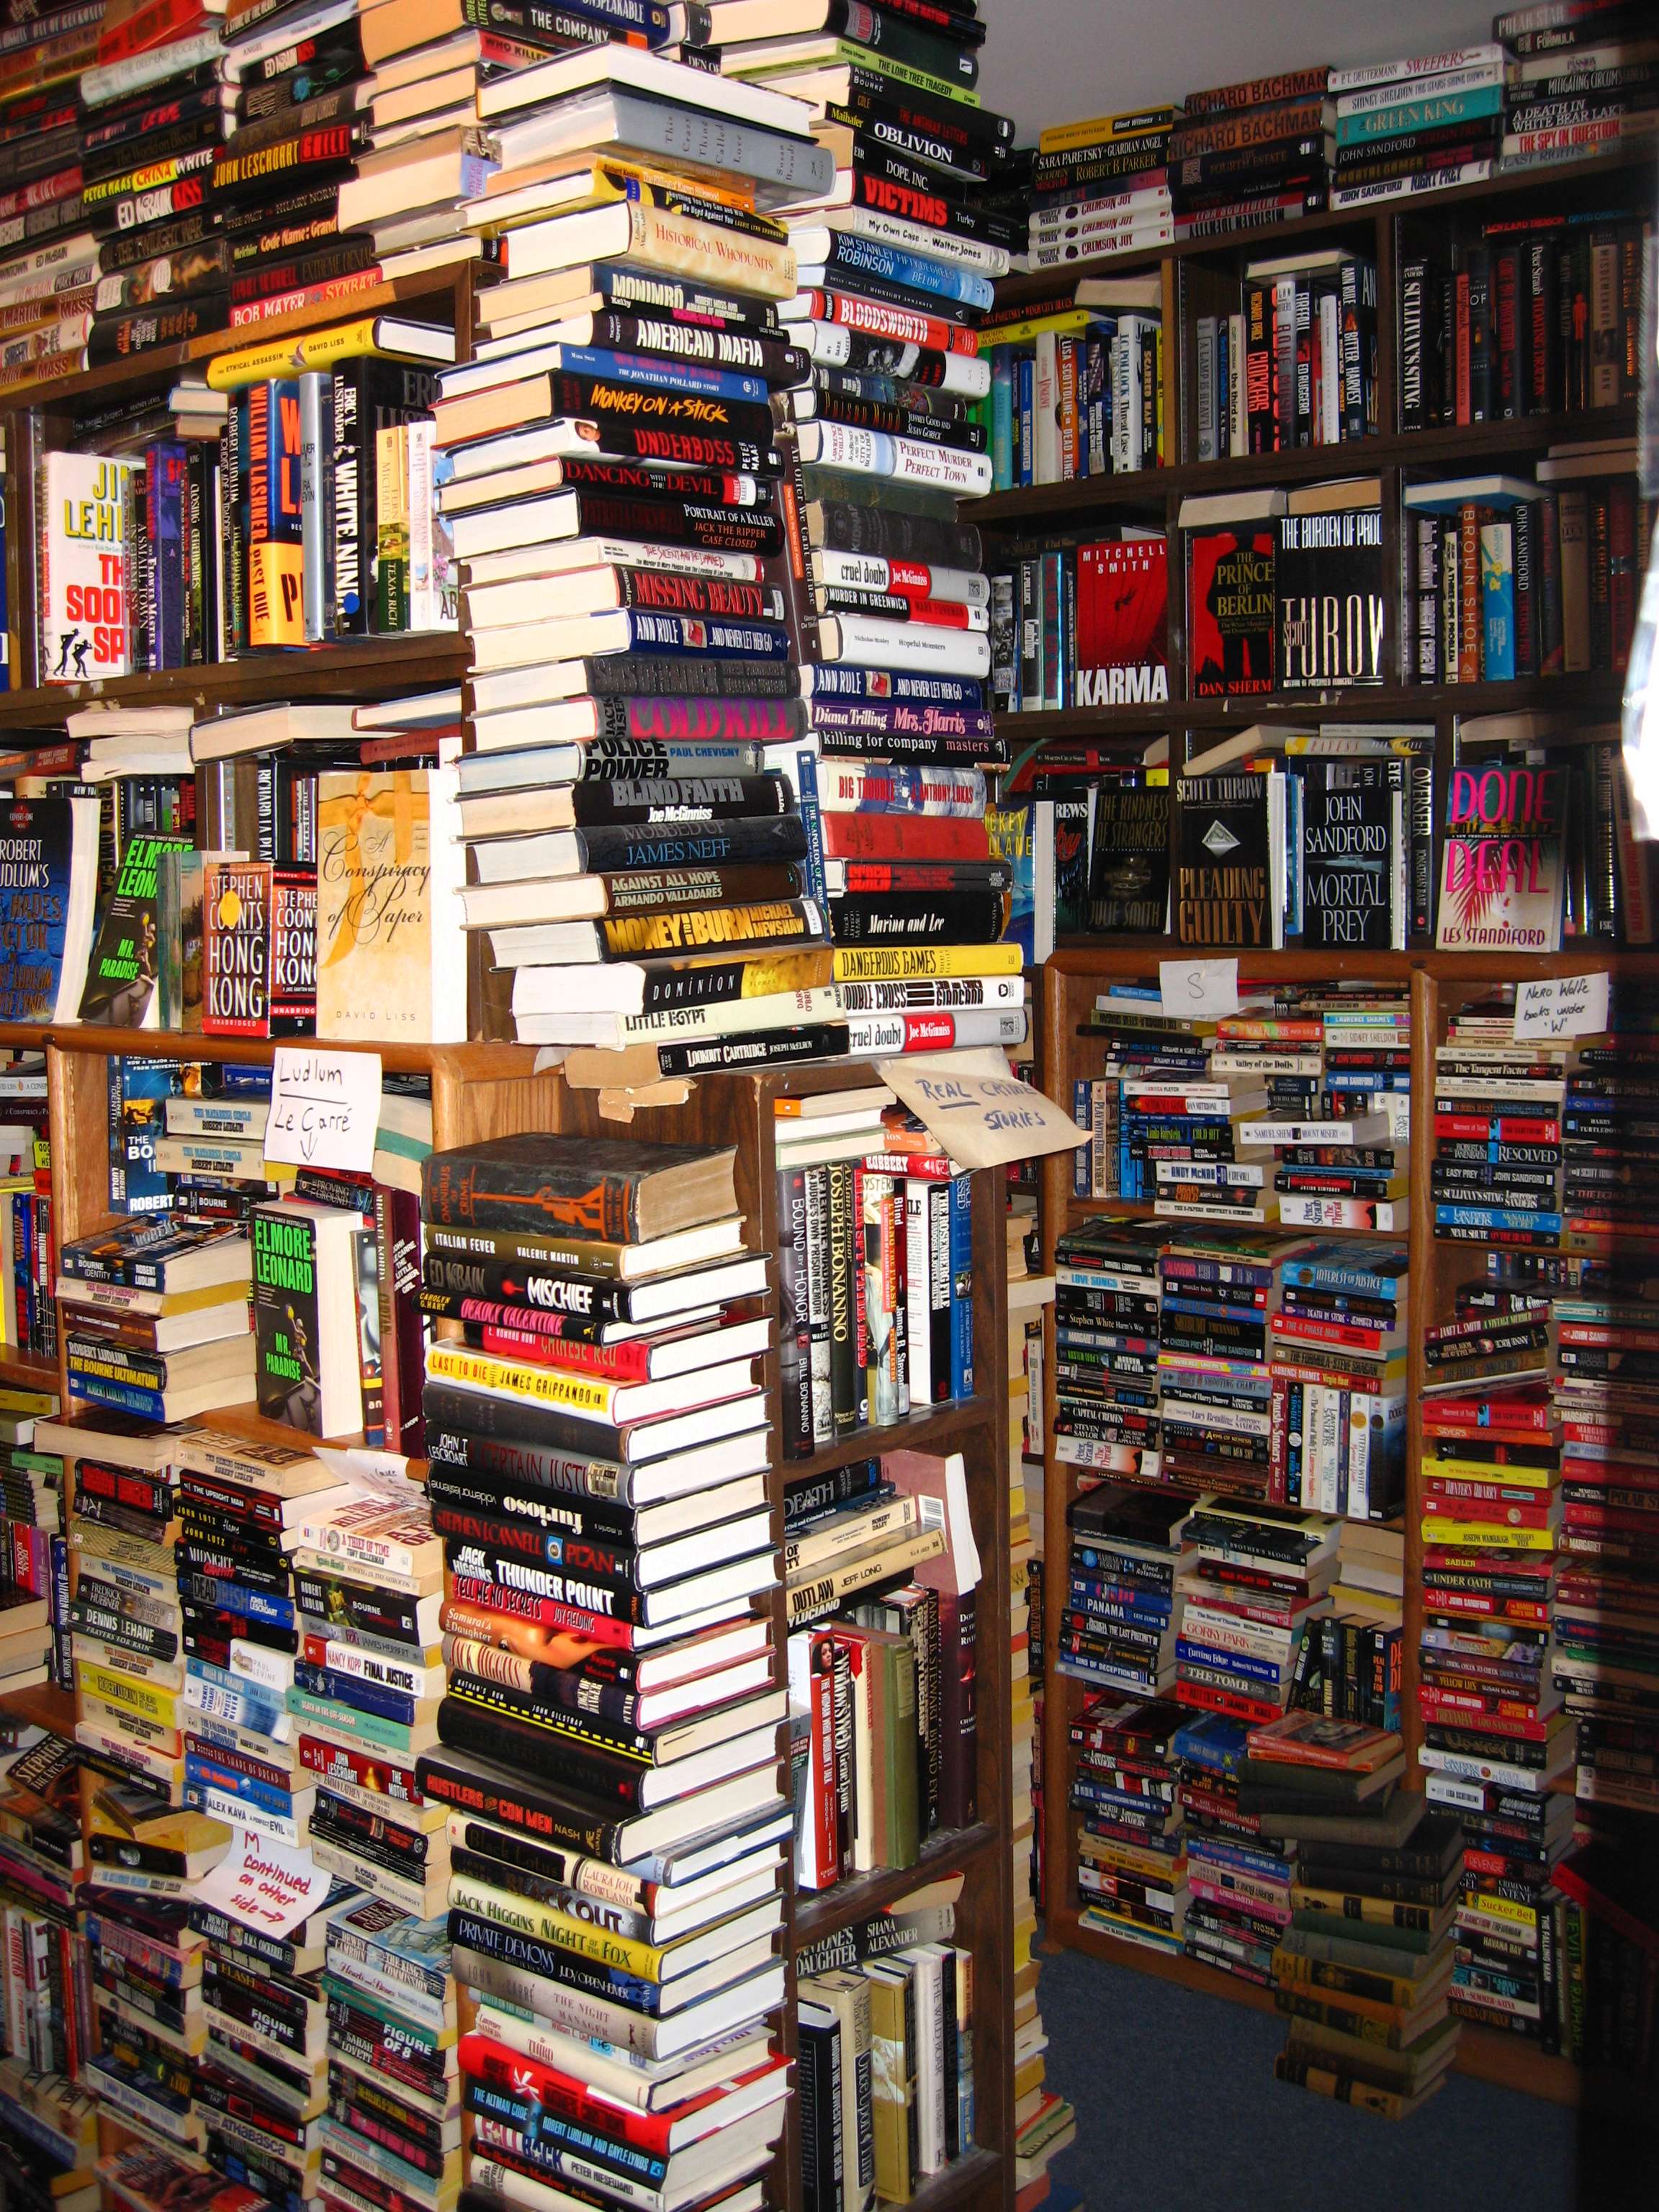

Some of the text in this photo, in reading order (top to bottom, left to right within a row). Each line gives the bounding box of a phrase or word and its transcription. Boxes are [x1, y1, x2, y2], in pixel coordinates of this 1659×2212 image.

[531, 8, 609, 44] THE COMPANY
[1406, 50, 1466, 73] SWEEPERS
[874, 122, 953, 163] OBLIVION
[1519, 120, 1620, 153] THE SPY IN QUESTION
[214, 131, 347, 187] JOHN LESCROART GUILT
[1038, 135, 1163, 171] SARA PARETSKY GUARDIAN ANGEL
[84, 181, 105, 204] PETER
[107, 174, 132, 197] MAAS
[135, 164, 173, 187] CHINA
[176, 150, 213, 176] WHITE
[886, 158, 930, 192] DOPE, INC.
[864, 177, 948, 227] VICTIMS
[656, 224, 773, 272] HISTORICAL WHODUNITS
[869, 219, 981, 259] My Own Case Walter Jones
[1082, 235, 1133, 256] CRIMSON JOY
[837, 248, 894, 275] ROBINSON
[841, 297, 928, 343] BLOODSWORTH
[637, 320, 714, 357] AMERICAN
[719, 337, 763, 368] MAFIA
[590, 385, 642, 413] MONKEY
[644, 397, 668, 413] ON
[683, 399, 728, 423] STICK
[635, 429, 735, 465] UNDERBOSS
[1082, 545, 1166, 561] MITCHELL
[1097, 560, 1149, 575] SMITH
[841, 562, 886, 586] cruel doubt
[636, 572, 763, 616] MISSING BEAUTY
[637, 615, 678, 644] ANN RULE
[1077, 665, 1169, 706] KARMA
[815, 705, 965, 735] Diana Trilling Mrs. Harris
[824, 730, 937, 754] killing for company
[611, 779, 745, 807] BLIND FAITH
[648, 806, 712, 822] Joe McGinniss
[1324, 796, 1362, 824] JOHN
[626, 838, 731, 865] JAMES NEFF
[1306, 826, 1387, 853] SANDFORD
[323, 832, 431, 897] Conspiracy
[1447, 840, 1550, 892] DEAL
[611, 871, 721, 891] AGAINST ALL HOPE
[1180, 867, 1266, 899] PLEADING
[1306, 873, 1385, 907] MORTAL
[327, 873, 423, 945] of Paper
[614, 886, 722, 907] ARMANDO VALLADARES
[1180, 899, 1265, 945] GUILTY
[1322, 909, 1368, 943] PREY
[1443, 927, 1547, 948] LES STANDIFORD
[209, 938, 263, 974] HONG
[842, 950, 936, 976] DANGEROUS GAMES
[209, 978, 263, 1018] KONG
[1187, 973, 1205, 998] S
[1559, 979, 1590, 997] Wolfe
[336, 1010, 416, 1022] DAVID LISS
[1524, 1004, 1585, 1021] books under
[280, 1058, 342, 1086] Ludlum
[1235, 1059, 1293, 1070] Valley of the Dolls
[274, 1105, 352, 1132] Le Carré
[984, 1105, 1046, 1130] STORIES
[1498, 1145, 1557, 1163] RESOLVED
[1446, 1167, 1545, 1184] EASY PREY JOHN SANDFORD
[255, 1220, 312, 1261] ELMORE
[436, 1234, 579, 1265] ITALIAN FEVER VALERIE MARTIN
[256, 1257, 313, 1295] LEONARD
[527, 1277, 593, 1314] MISCHIEF
[792, 1197, 810, 1434] BOUND BY HONOR BILL BONANNO
[275, 1332, 291, 1355] MR.
[266, 1353, 301, 1382] PARADISE
[432, 1357, 487, 1379] LAST TO DIE
[500, 1370, 591, 1404] JAMES GRIPPANDO
[503, 1495, 583, 1536] furioso
[1445, 1557, 1476, 1568] SADLER
[496, 1559, 614, 1616] THUNDER POINT
[793, 1564, 882, 1611] OUTLAW JEFF LONG
[1434, 1575, 1492, 1589] UNDER OATH
[1087, 1599, 1125, 1619] PANAMA
[86, 1609, 154, 1642] DENNIS LEHANE
[1187, 1623, 1250, 1648] GORKY PARK
[363, 1660, 413, 1690] FINAL JUSTICE
[427, 1774, 580, 1840] HUSTLERS CON MEN NASH
[245, 1831, 260, 1852] M
[243, 1854, 312, 1895] continued
[230, 1894, 258, 1912] side
[240, 1873, 297, 1907] on other
[1482, 1899, 1533, 1921] Sucker Bet
[453, 1889, 632, 1969] JACK HIGGINS NIGHT FOX
[868, 1928, 917, 1954] ALEXANDER
[796, 1945, 857, 1975] DAUGHTER
[384, 2023, 431, 2055] FIGURE
[385, 2038, 412, 2058] OF 8
